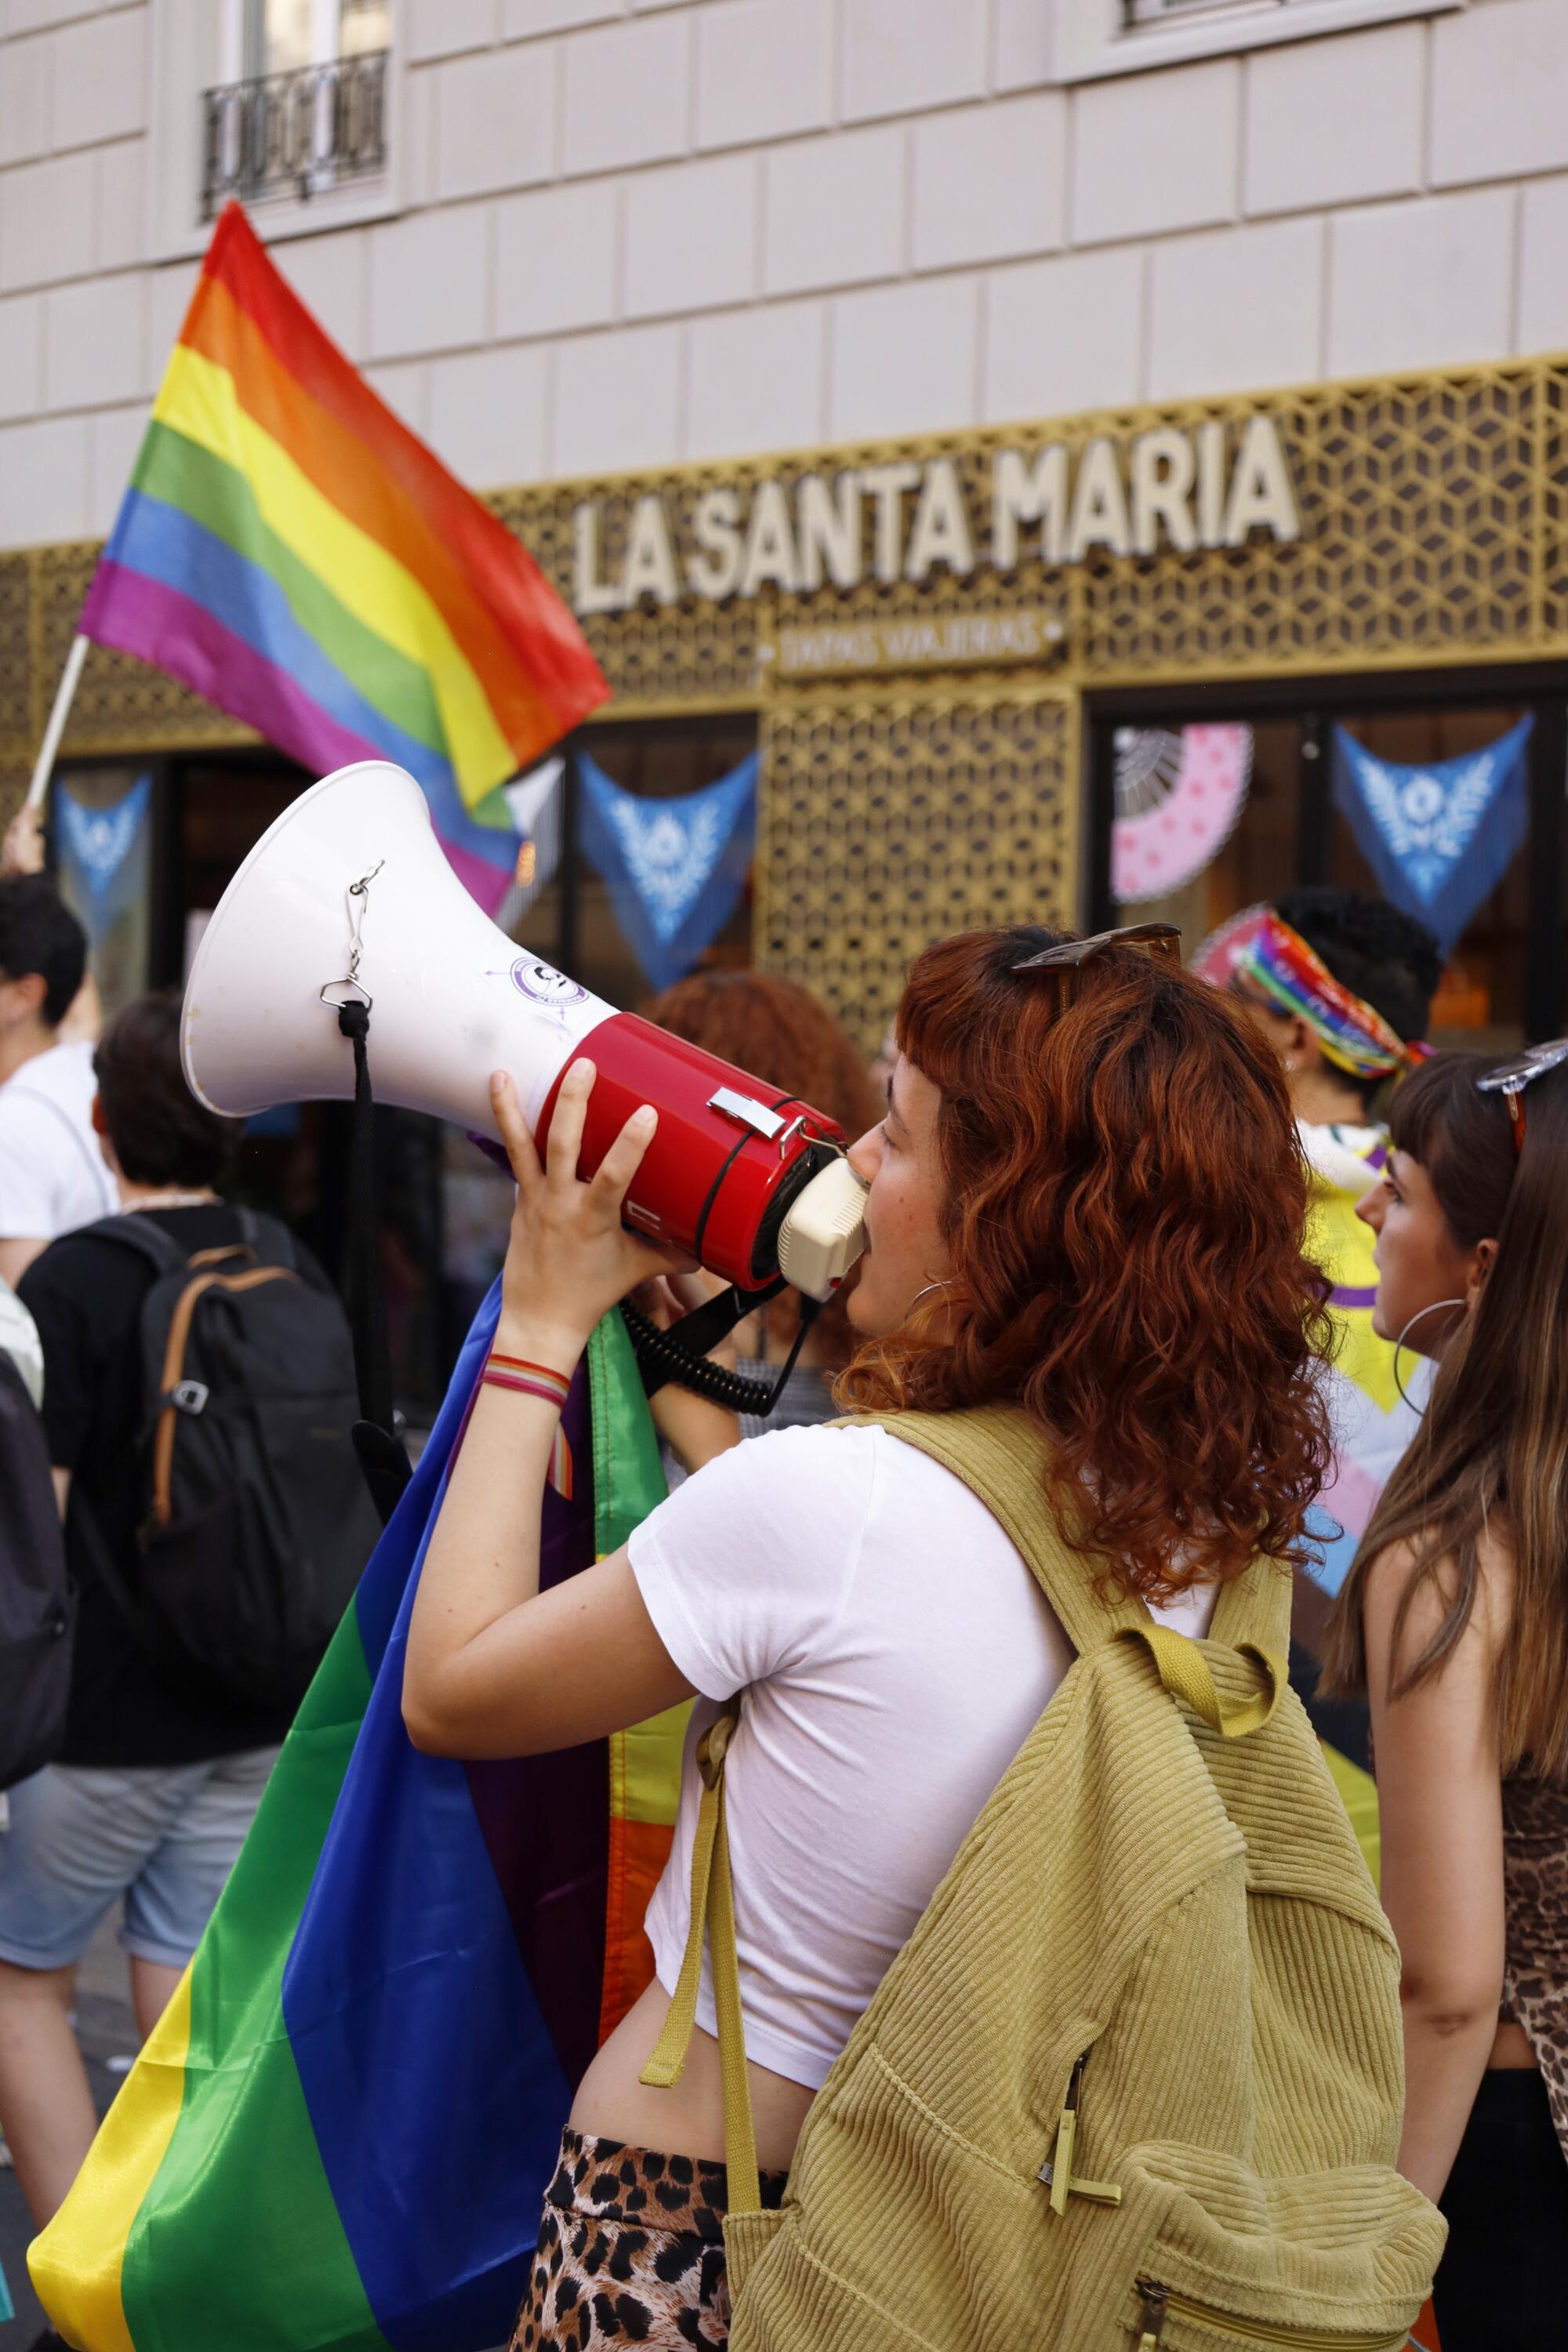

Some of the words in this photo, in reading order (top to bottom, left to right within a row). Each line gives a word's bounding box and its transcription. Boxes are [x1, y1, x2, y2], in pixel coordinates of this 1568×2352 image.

[575, 495, 677, 614] LA
[689, 458, 974, 601] SANTA
[991, 415, 1300, 573] MARIA
